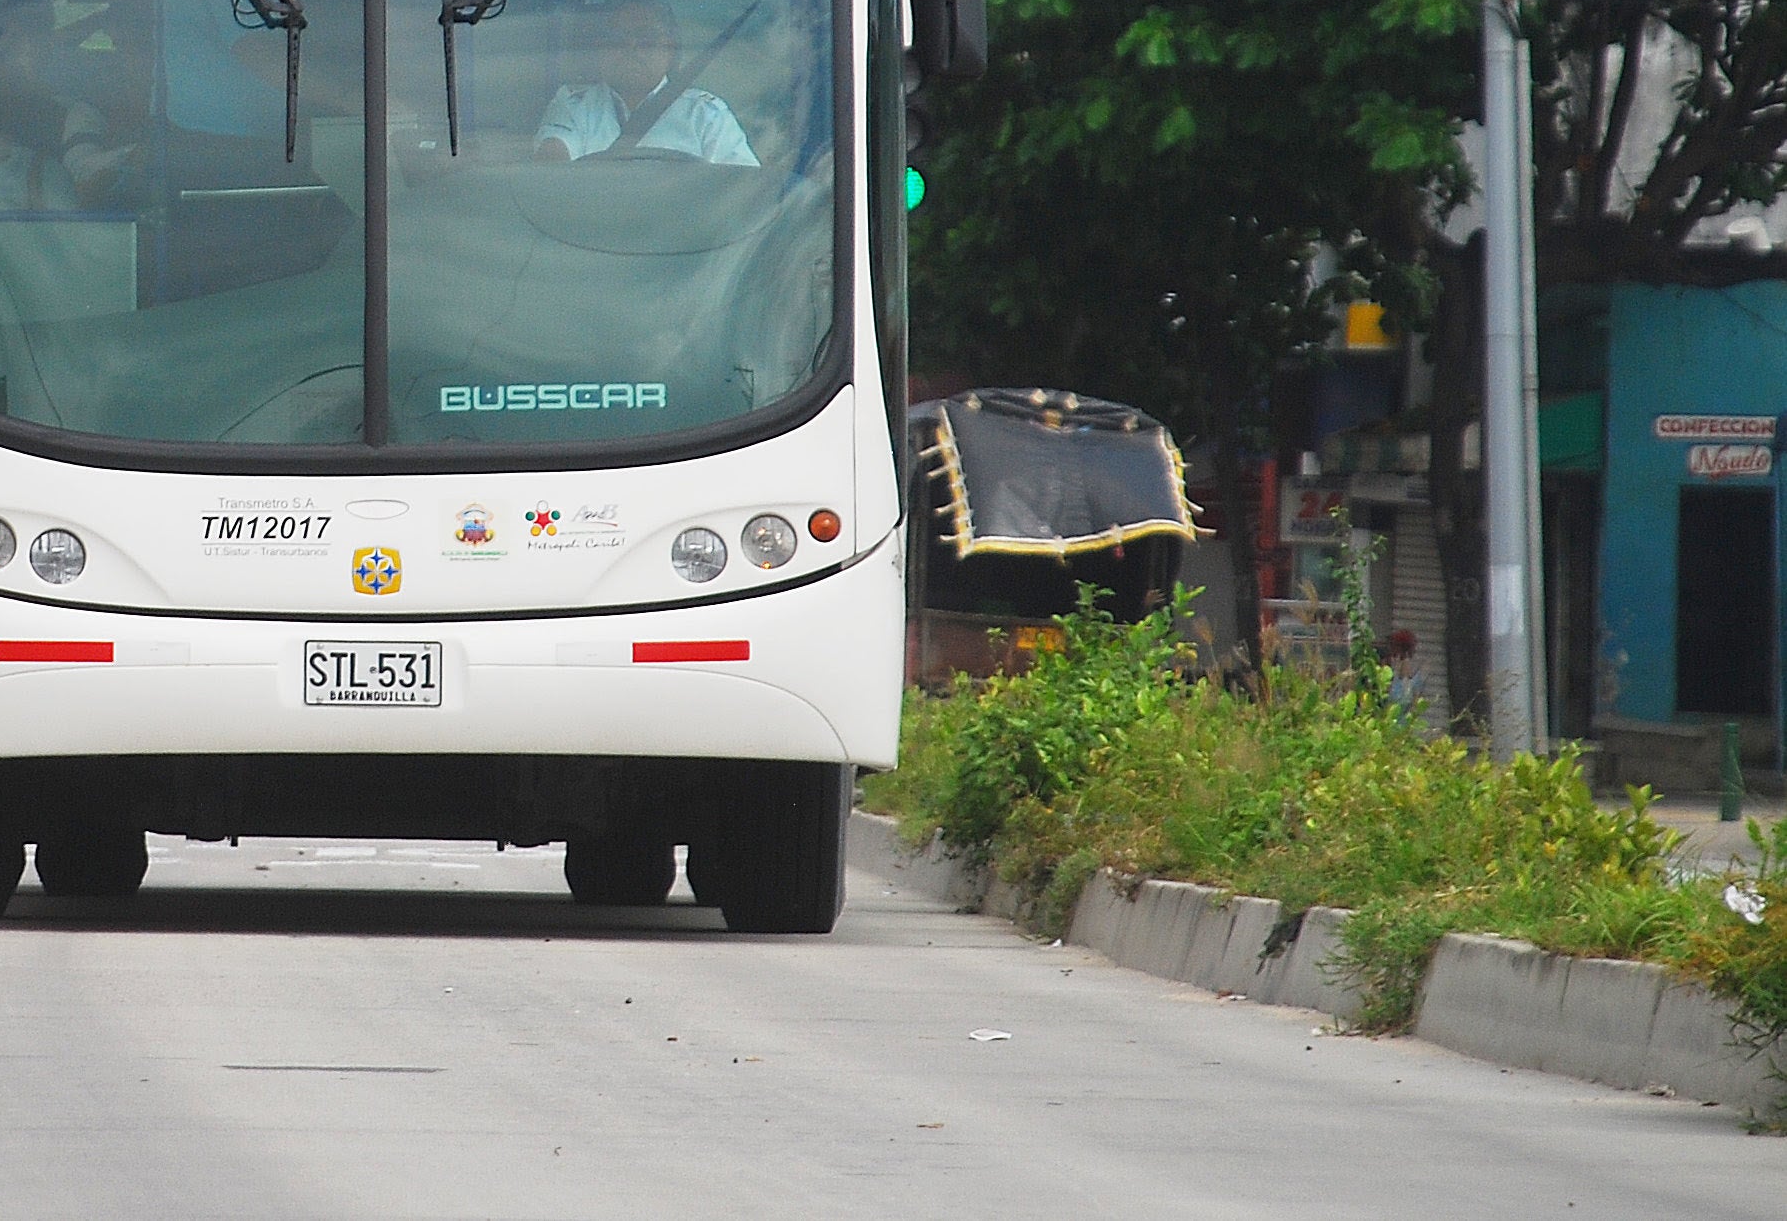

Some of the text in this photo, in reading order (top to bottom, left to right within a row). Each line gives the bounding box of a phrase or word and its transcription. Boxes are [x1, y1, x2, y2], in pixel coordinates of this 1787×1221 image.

[440, 383, 667, 412] BUSSCAR
[218, 496, 292, 510] Transmetro
[202, 516, 332, 539] TM12017
